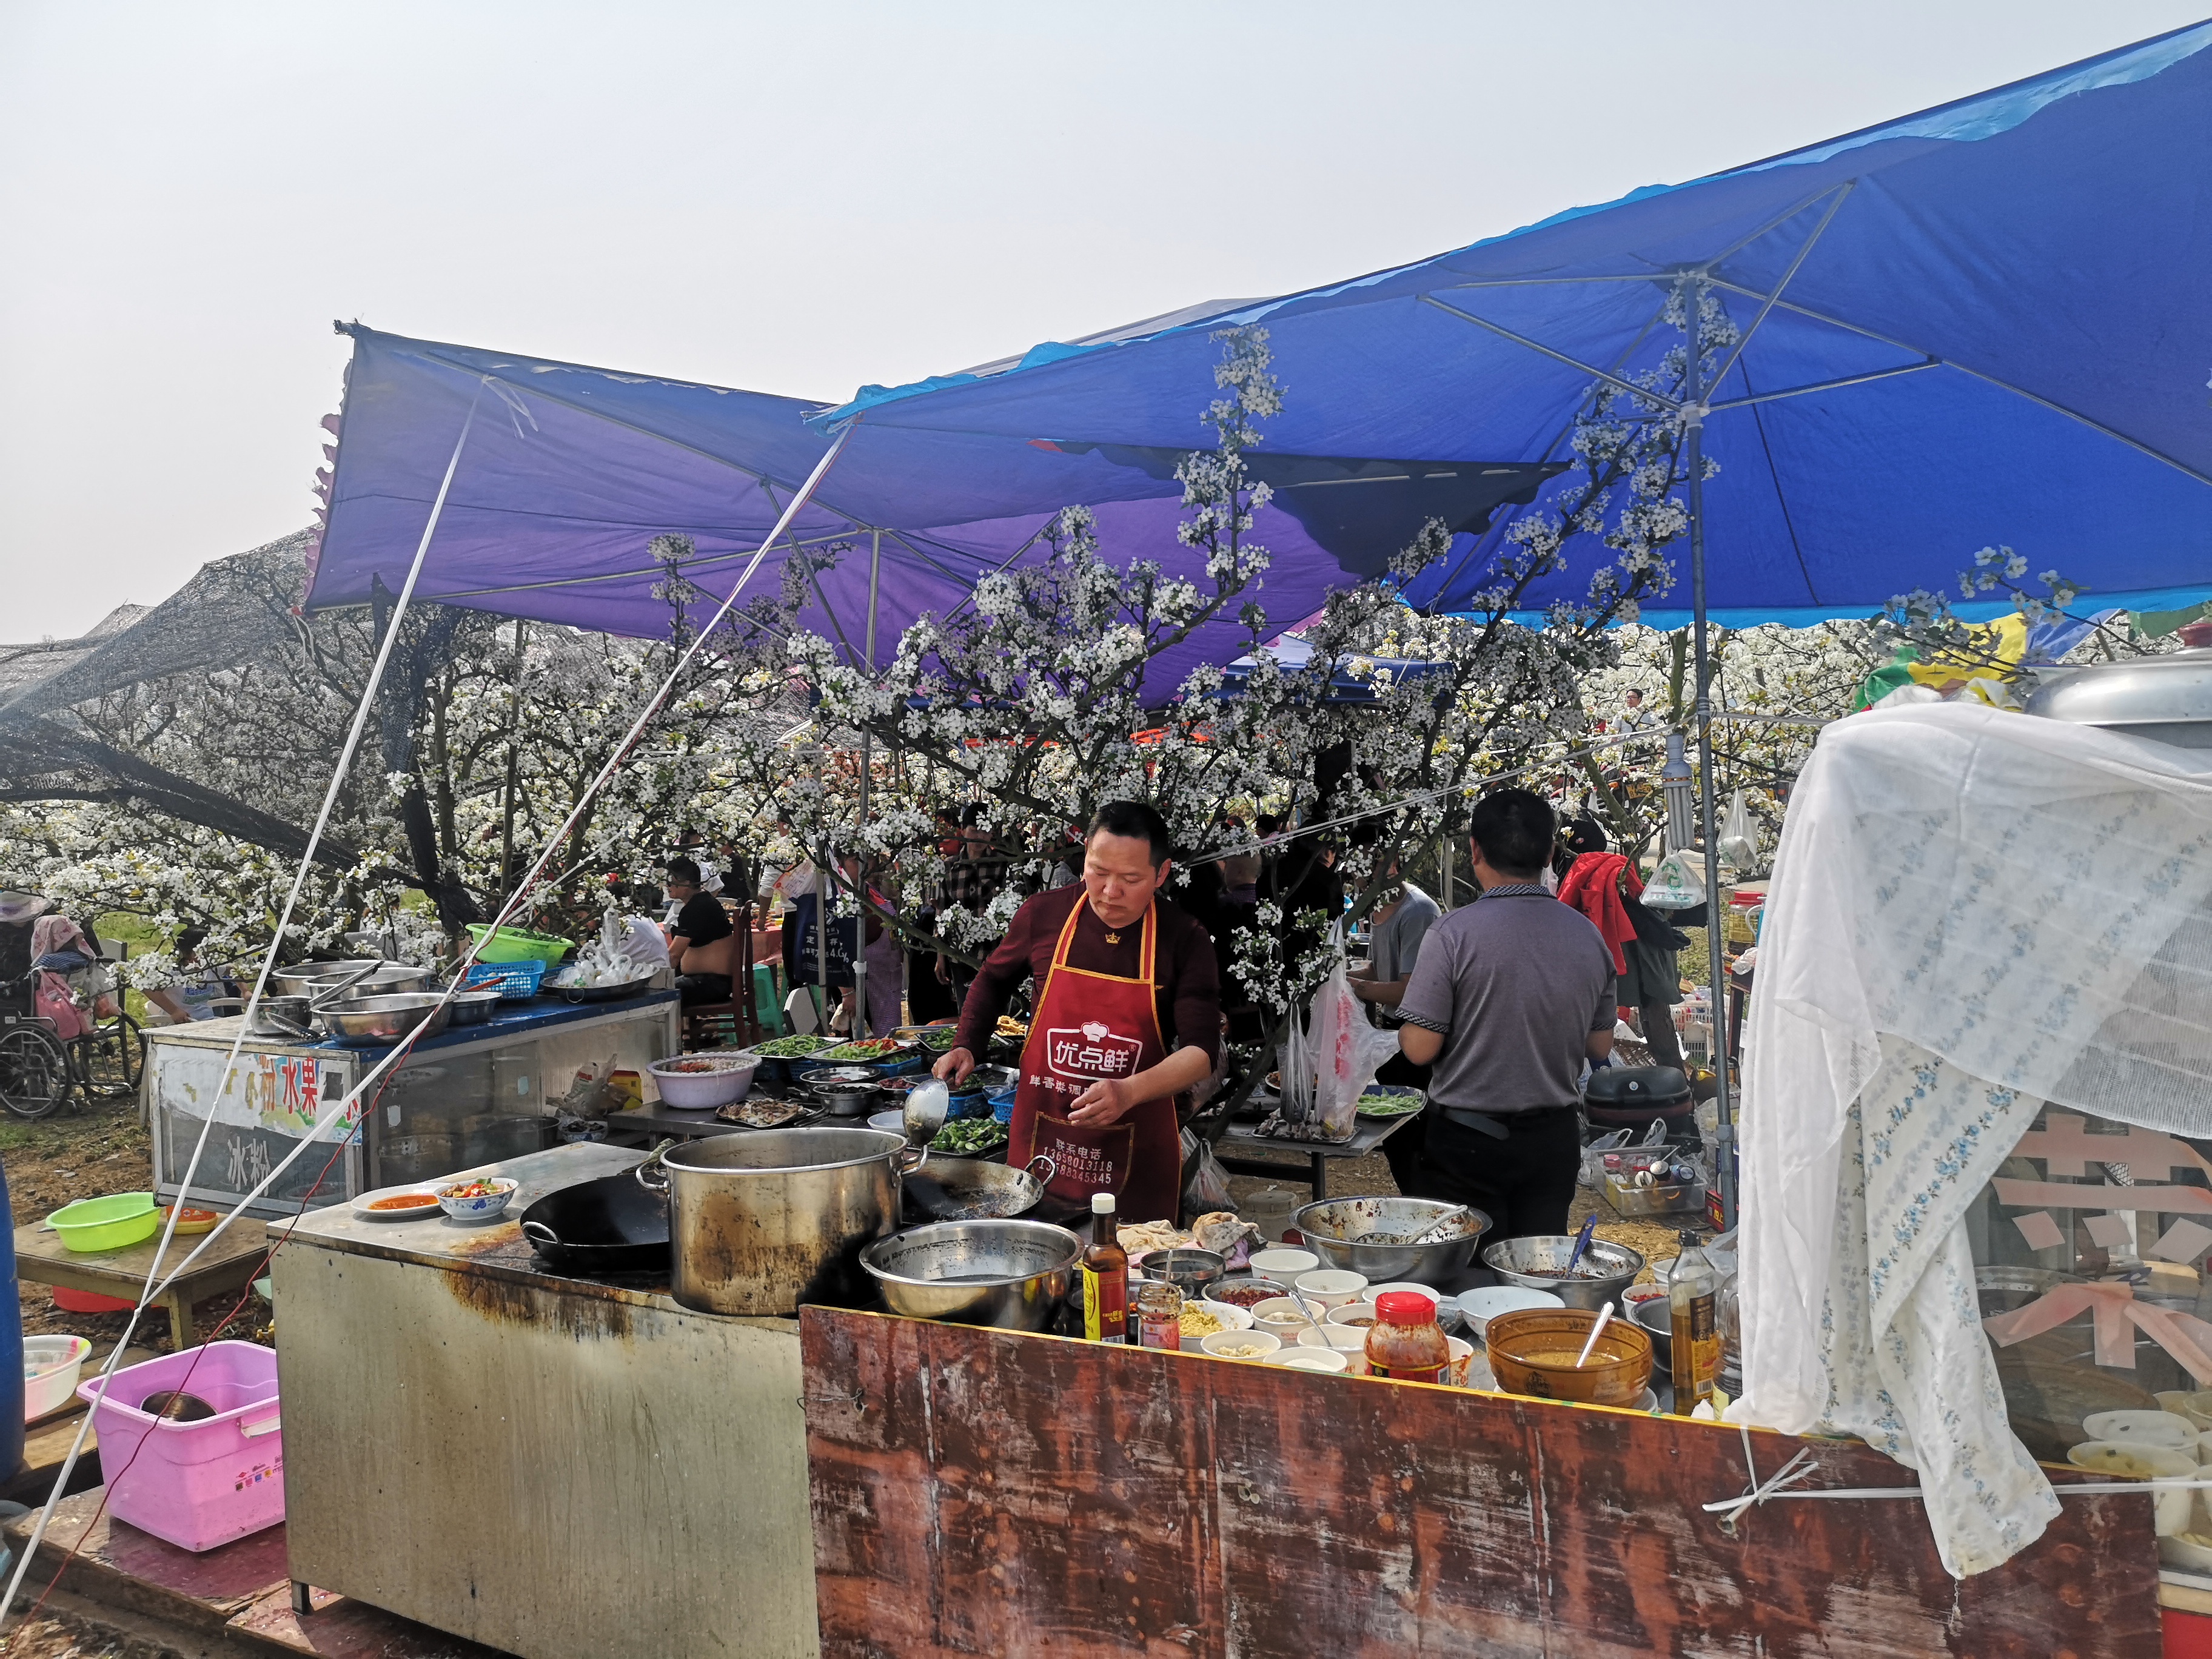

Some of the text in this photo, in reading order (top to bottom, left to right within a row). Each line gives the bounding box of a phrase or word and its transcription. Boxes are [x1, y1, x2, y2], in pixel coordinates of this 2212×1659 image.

[1054, 1041, 1130, 1072] 优点鲜
[1056, 1138, 1101, 1161] 联系电话
